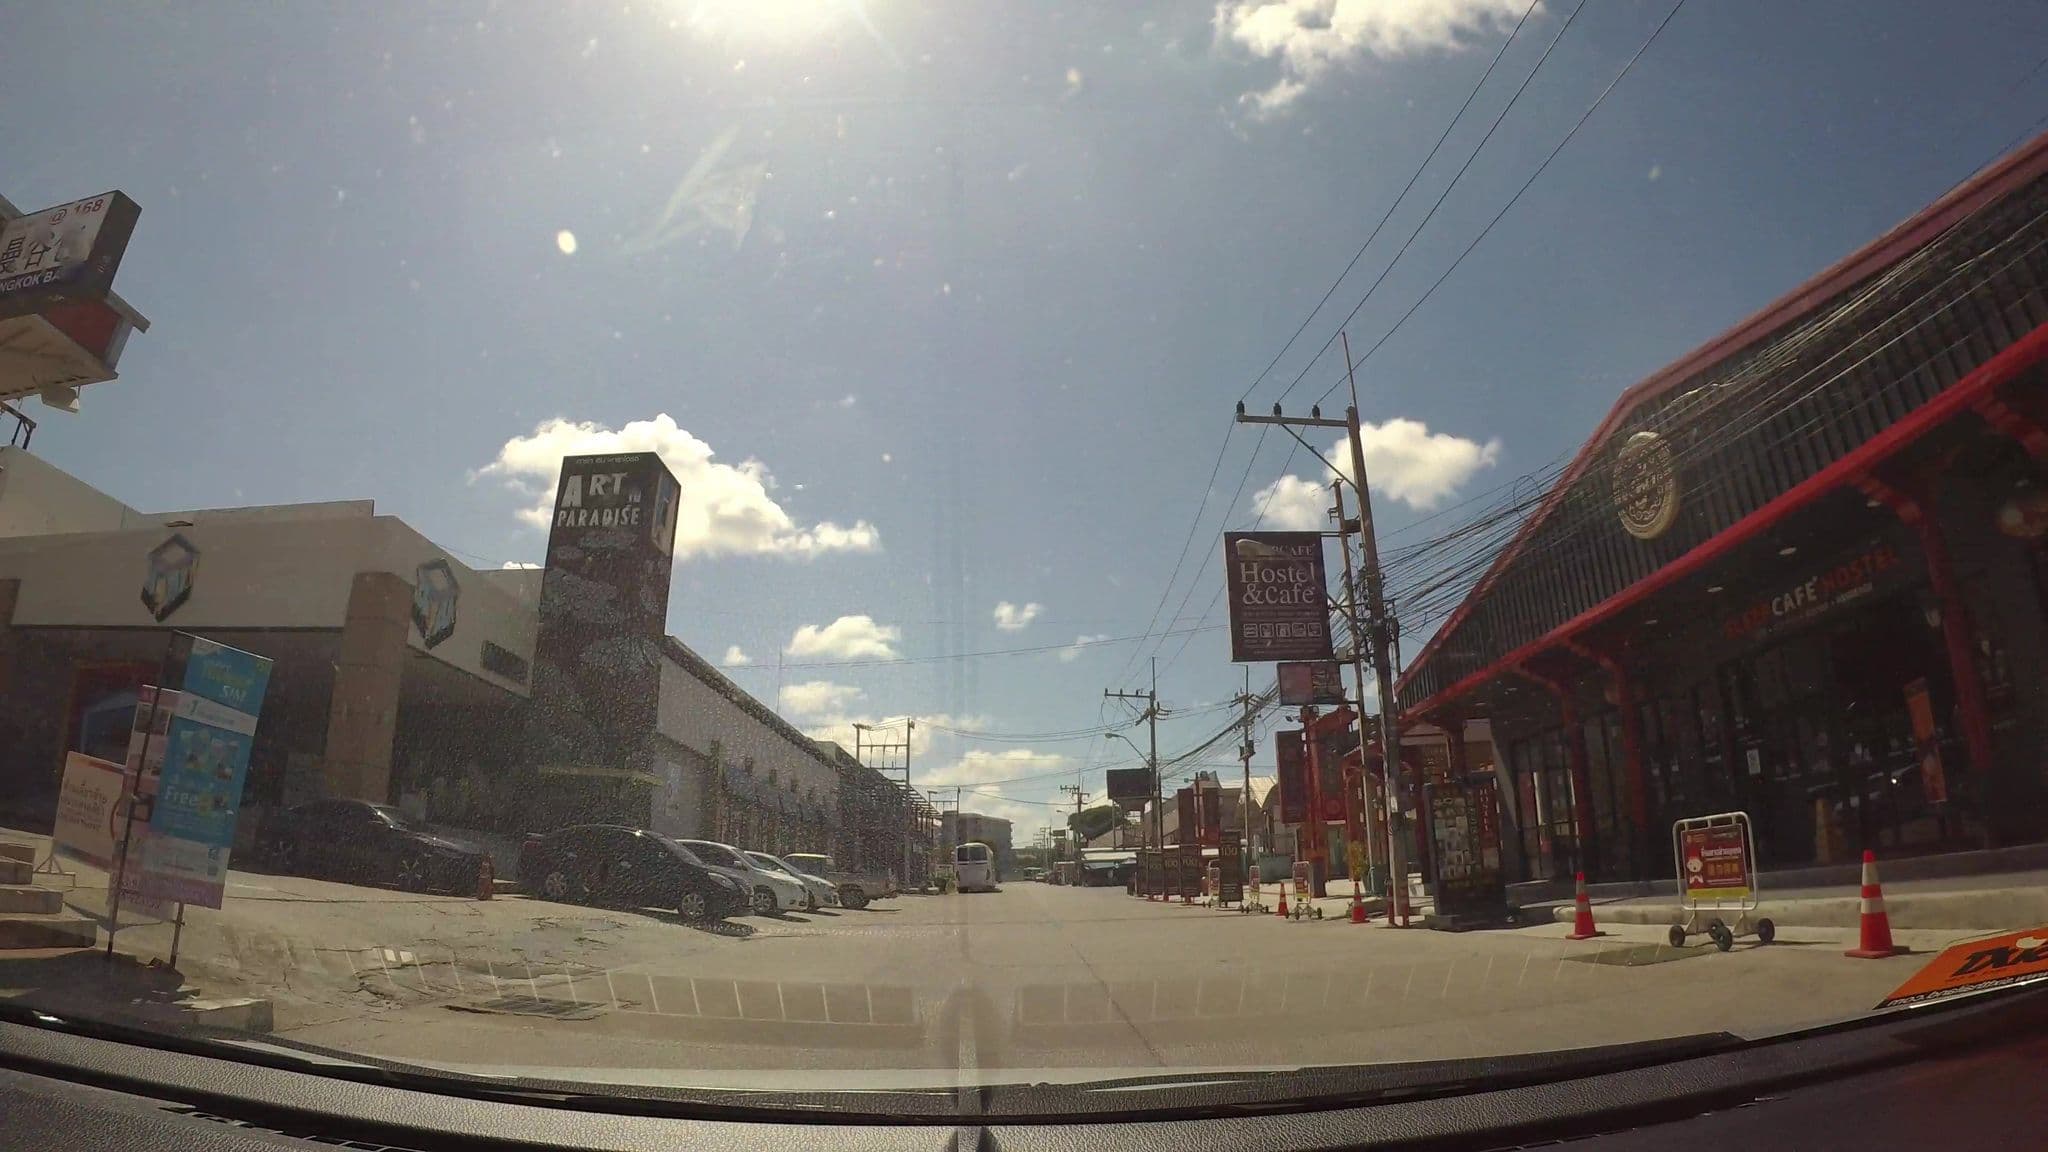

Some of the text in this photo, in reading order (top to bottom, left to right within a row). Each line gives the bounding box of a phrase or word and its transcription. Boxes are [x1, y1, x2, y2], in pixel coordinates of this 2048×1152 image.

[74, 198, 104, 215] 168
[560, 472, 629, 508] ART
[557, 505, 641, 528] PARADISE
[1240, 561, 1316, 584] Hostel
[164, 785, 199, 808] Free
